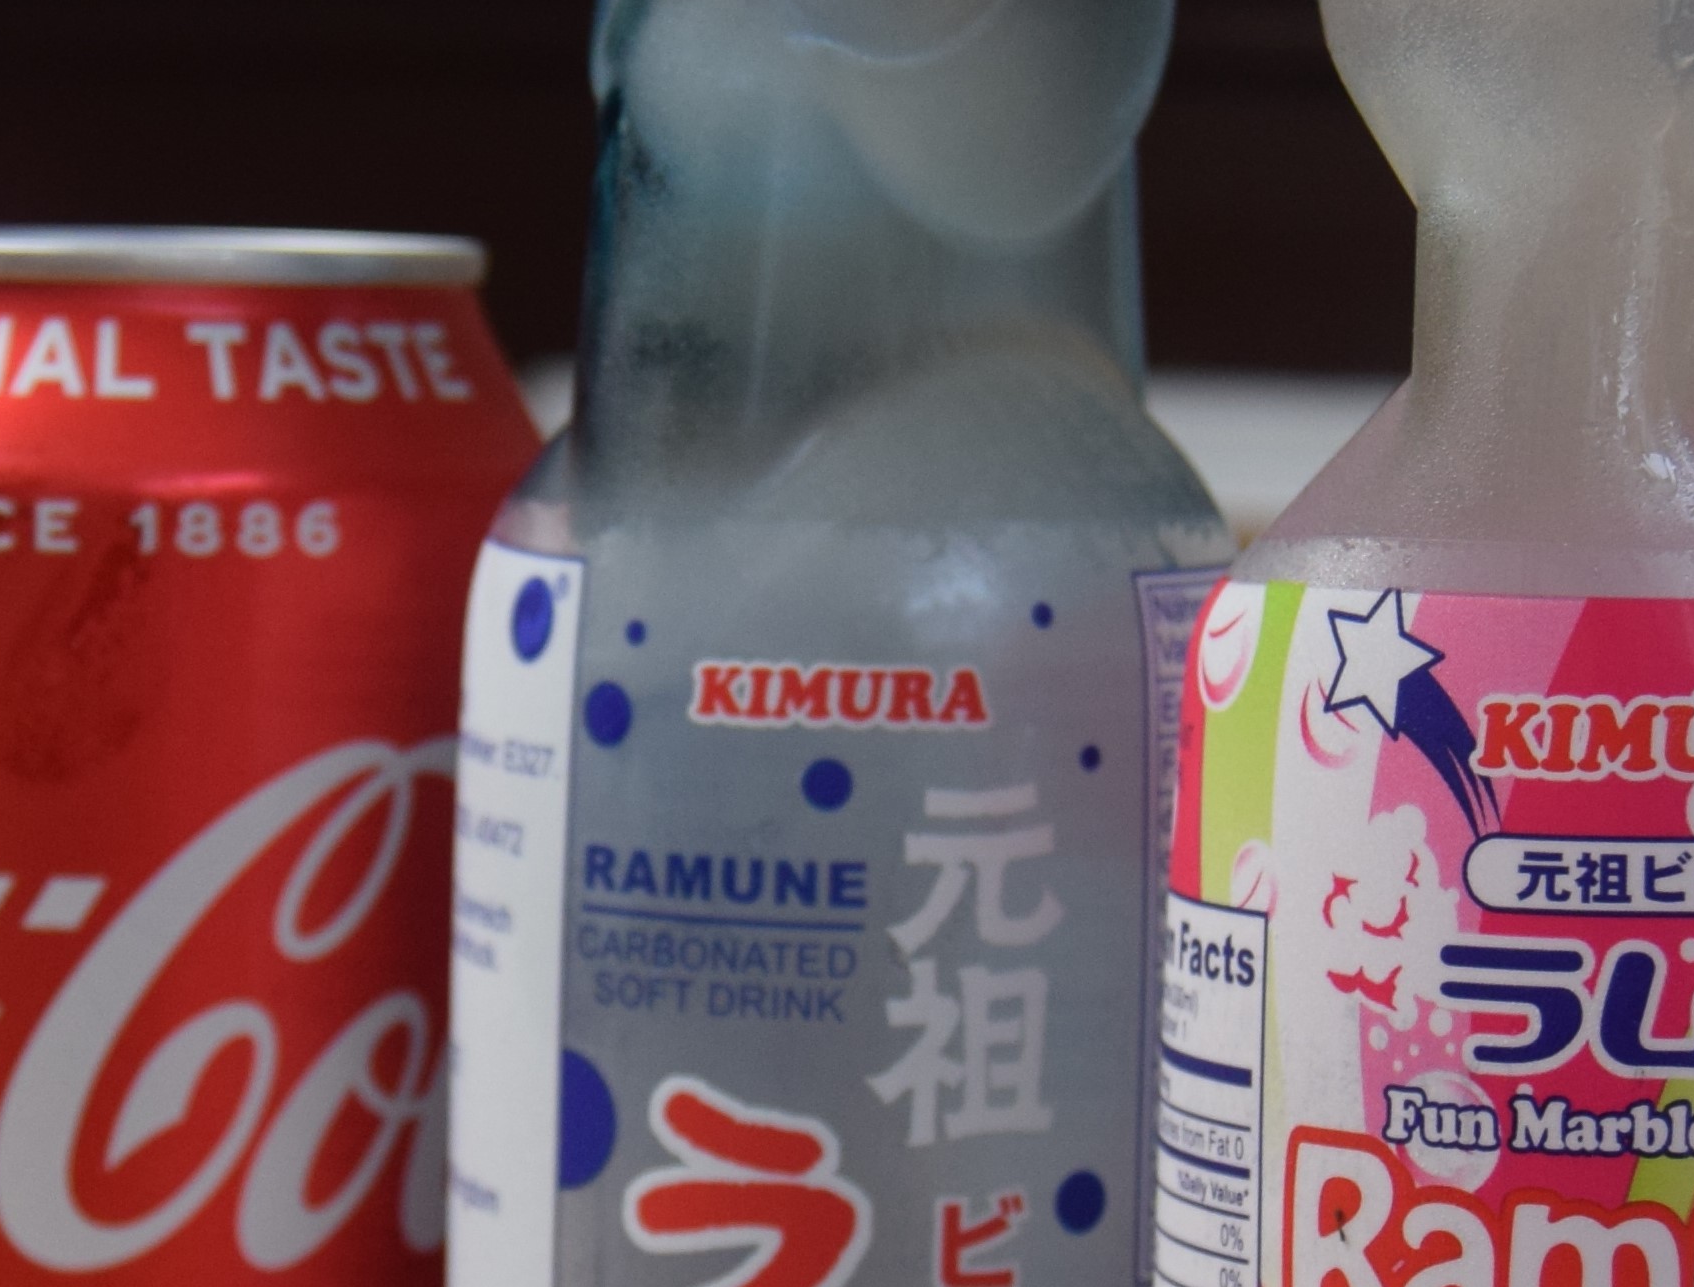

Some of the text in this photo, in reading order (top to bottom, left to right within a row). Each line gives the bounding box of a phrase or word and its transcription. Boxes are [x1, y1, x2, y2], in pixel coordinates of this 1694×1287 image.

[187, 319, 473, 403] TASTE
[131, 500, 342, 557] 1886
[691, 662, 991, 726] KIMURA
[583, 843, 868, 908] RAMUNE
[574, 924, 858, 981] CARBONATED
[1179, 921, 1256, 988] Facts
[593, 972, 846, 1024] SOFT DRINK
[1384, 1089, 1497, 1152] Fun
